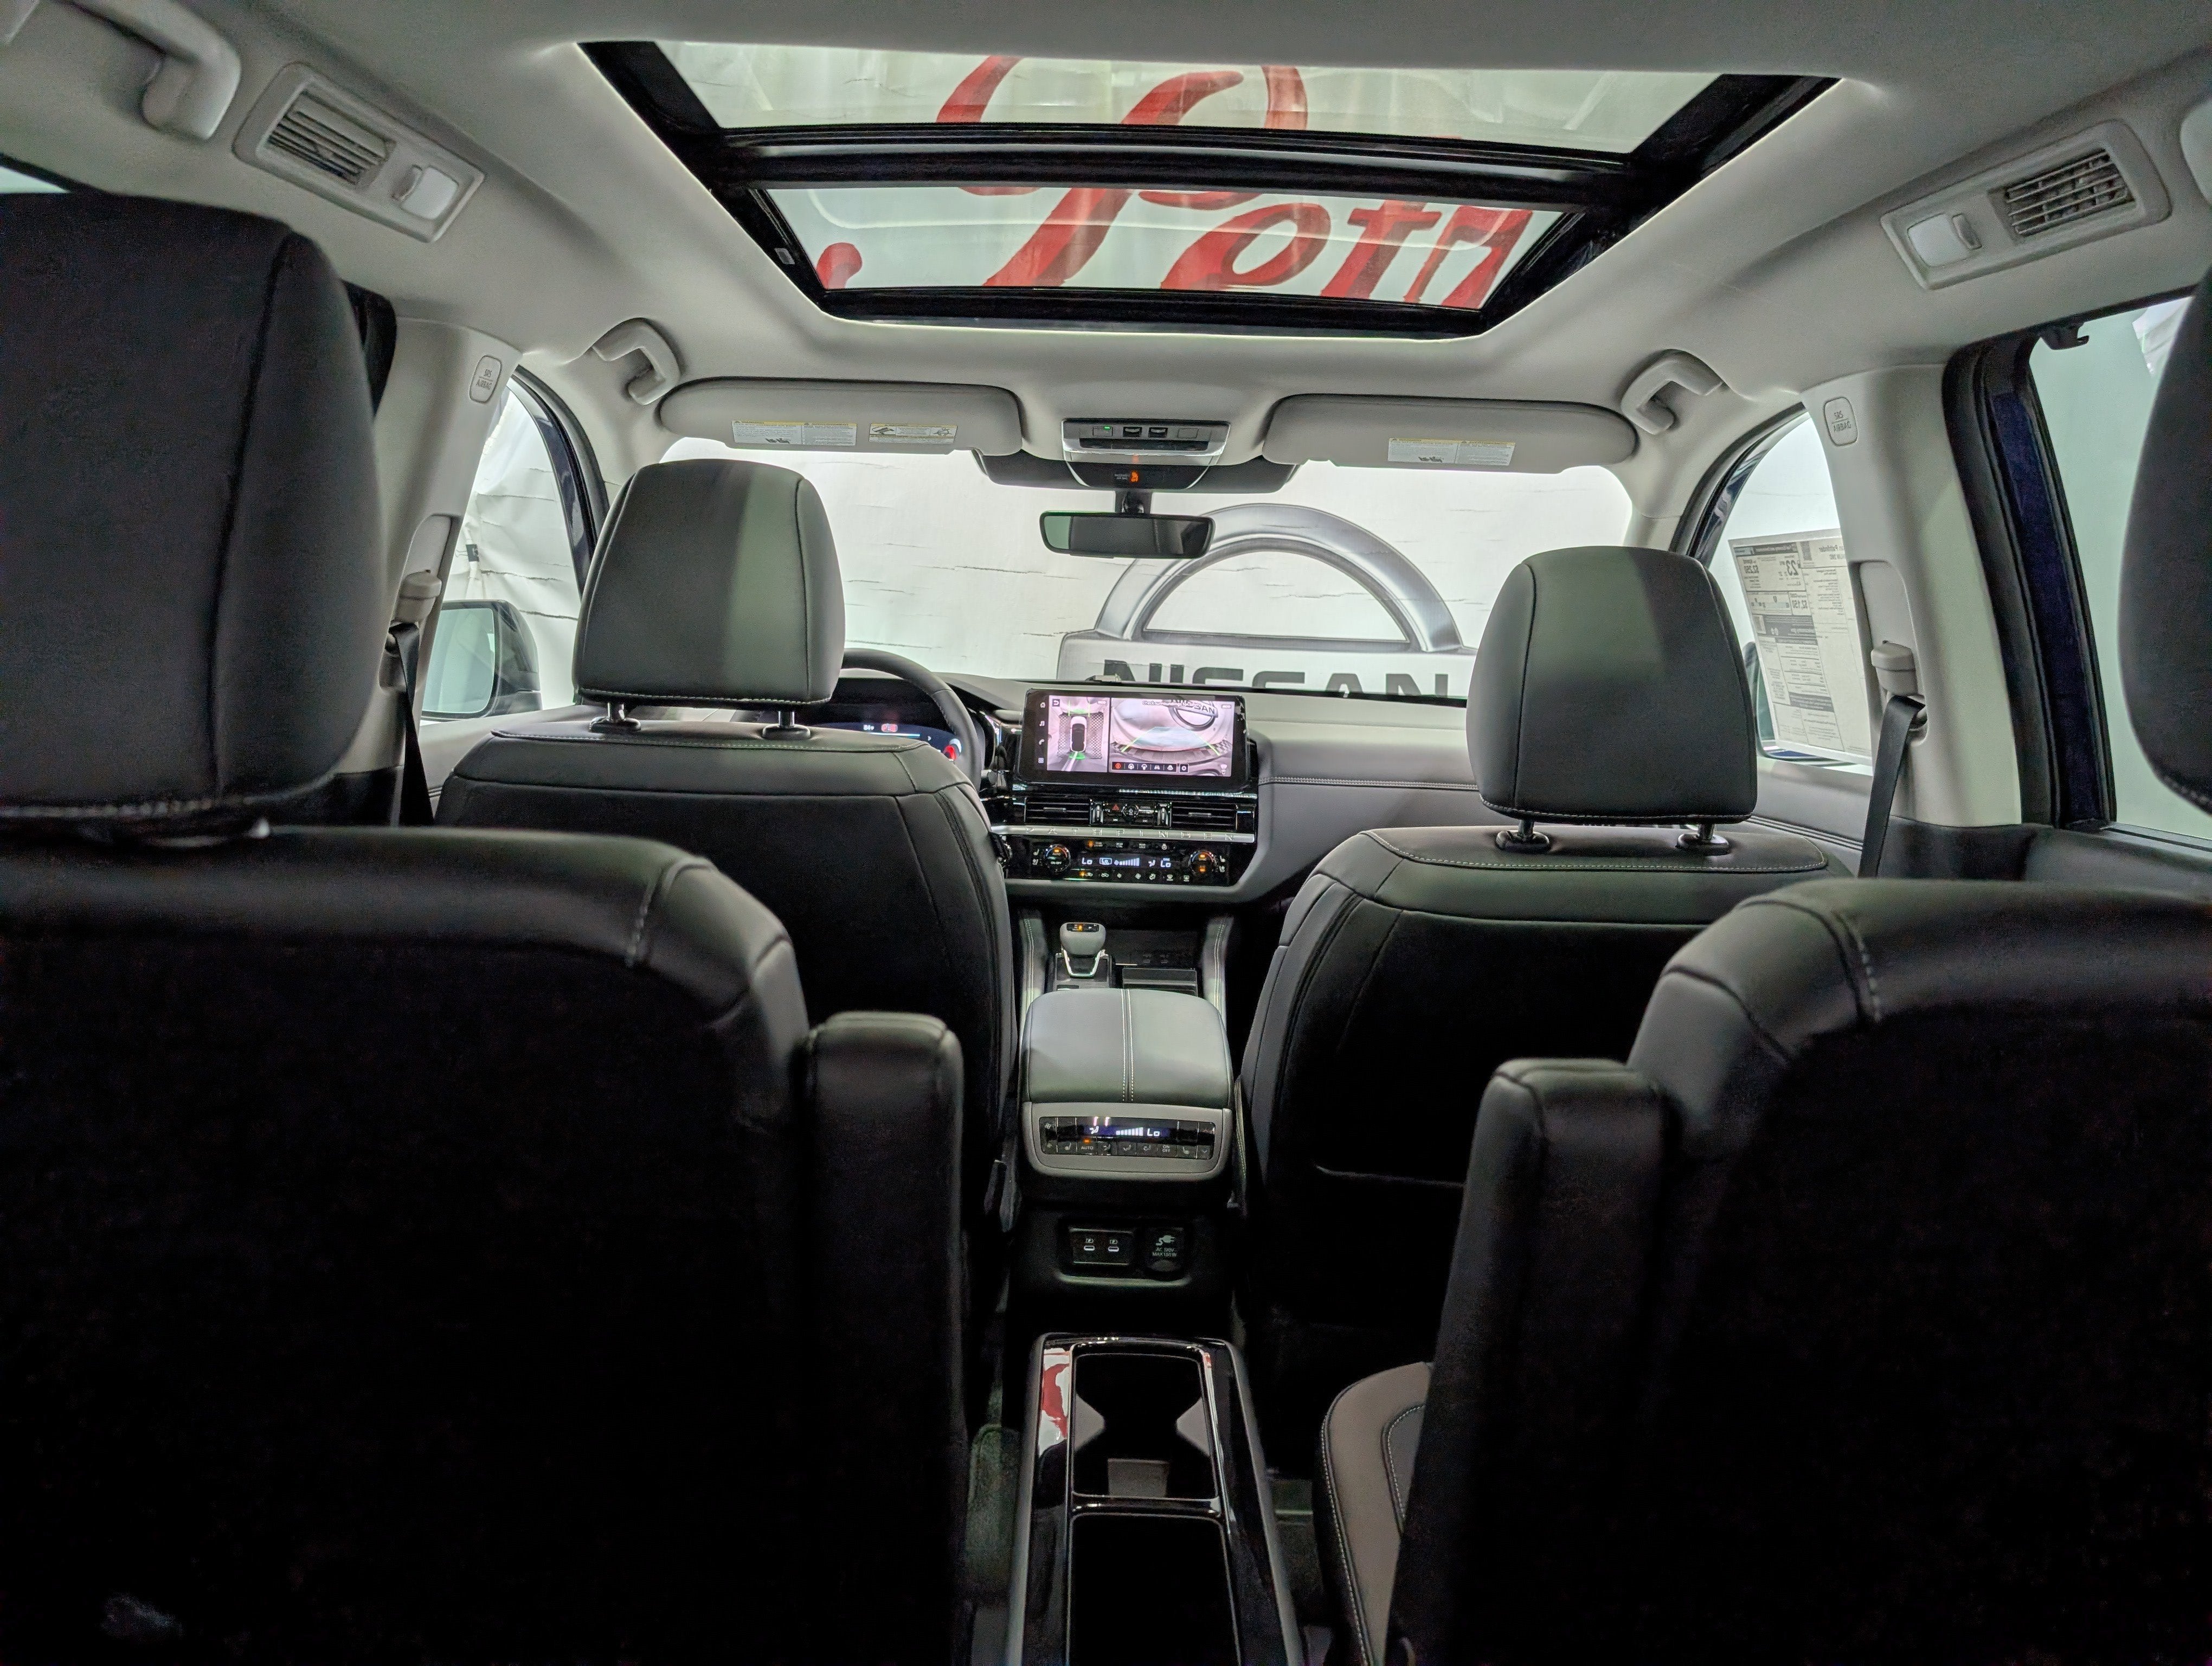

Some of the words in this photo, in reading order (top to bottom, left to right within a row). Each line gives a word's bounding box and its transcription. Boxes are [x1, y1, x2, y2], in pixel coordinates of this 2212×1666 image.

[1833, 419, 1851, 433] AIRBAG
[1025, 826, 1236, 841] PATHFINDER
[1147, 1128, 1160, 1137] Lo
